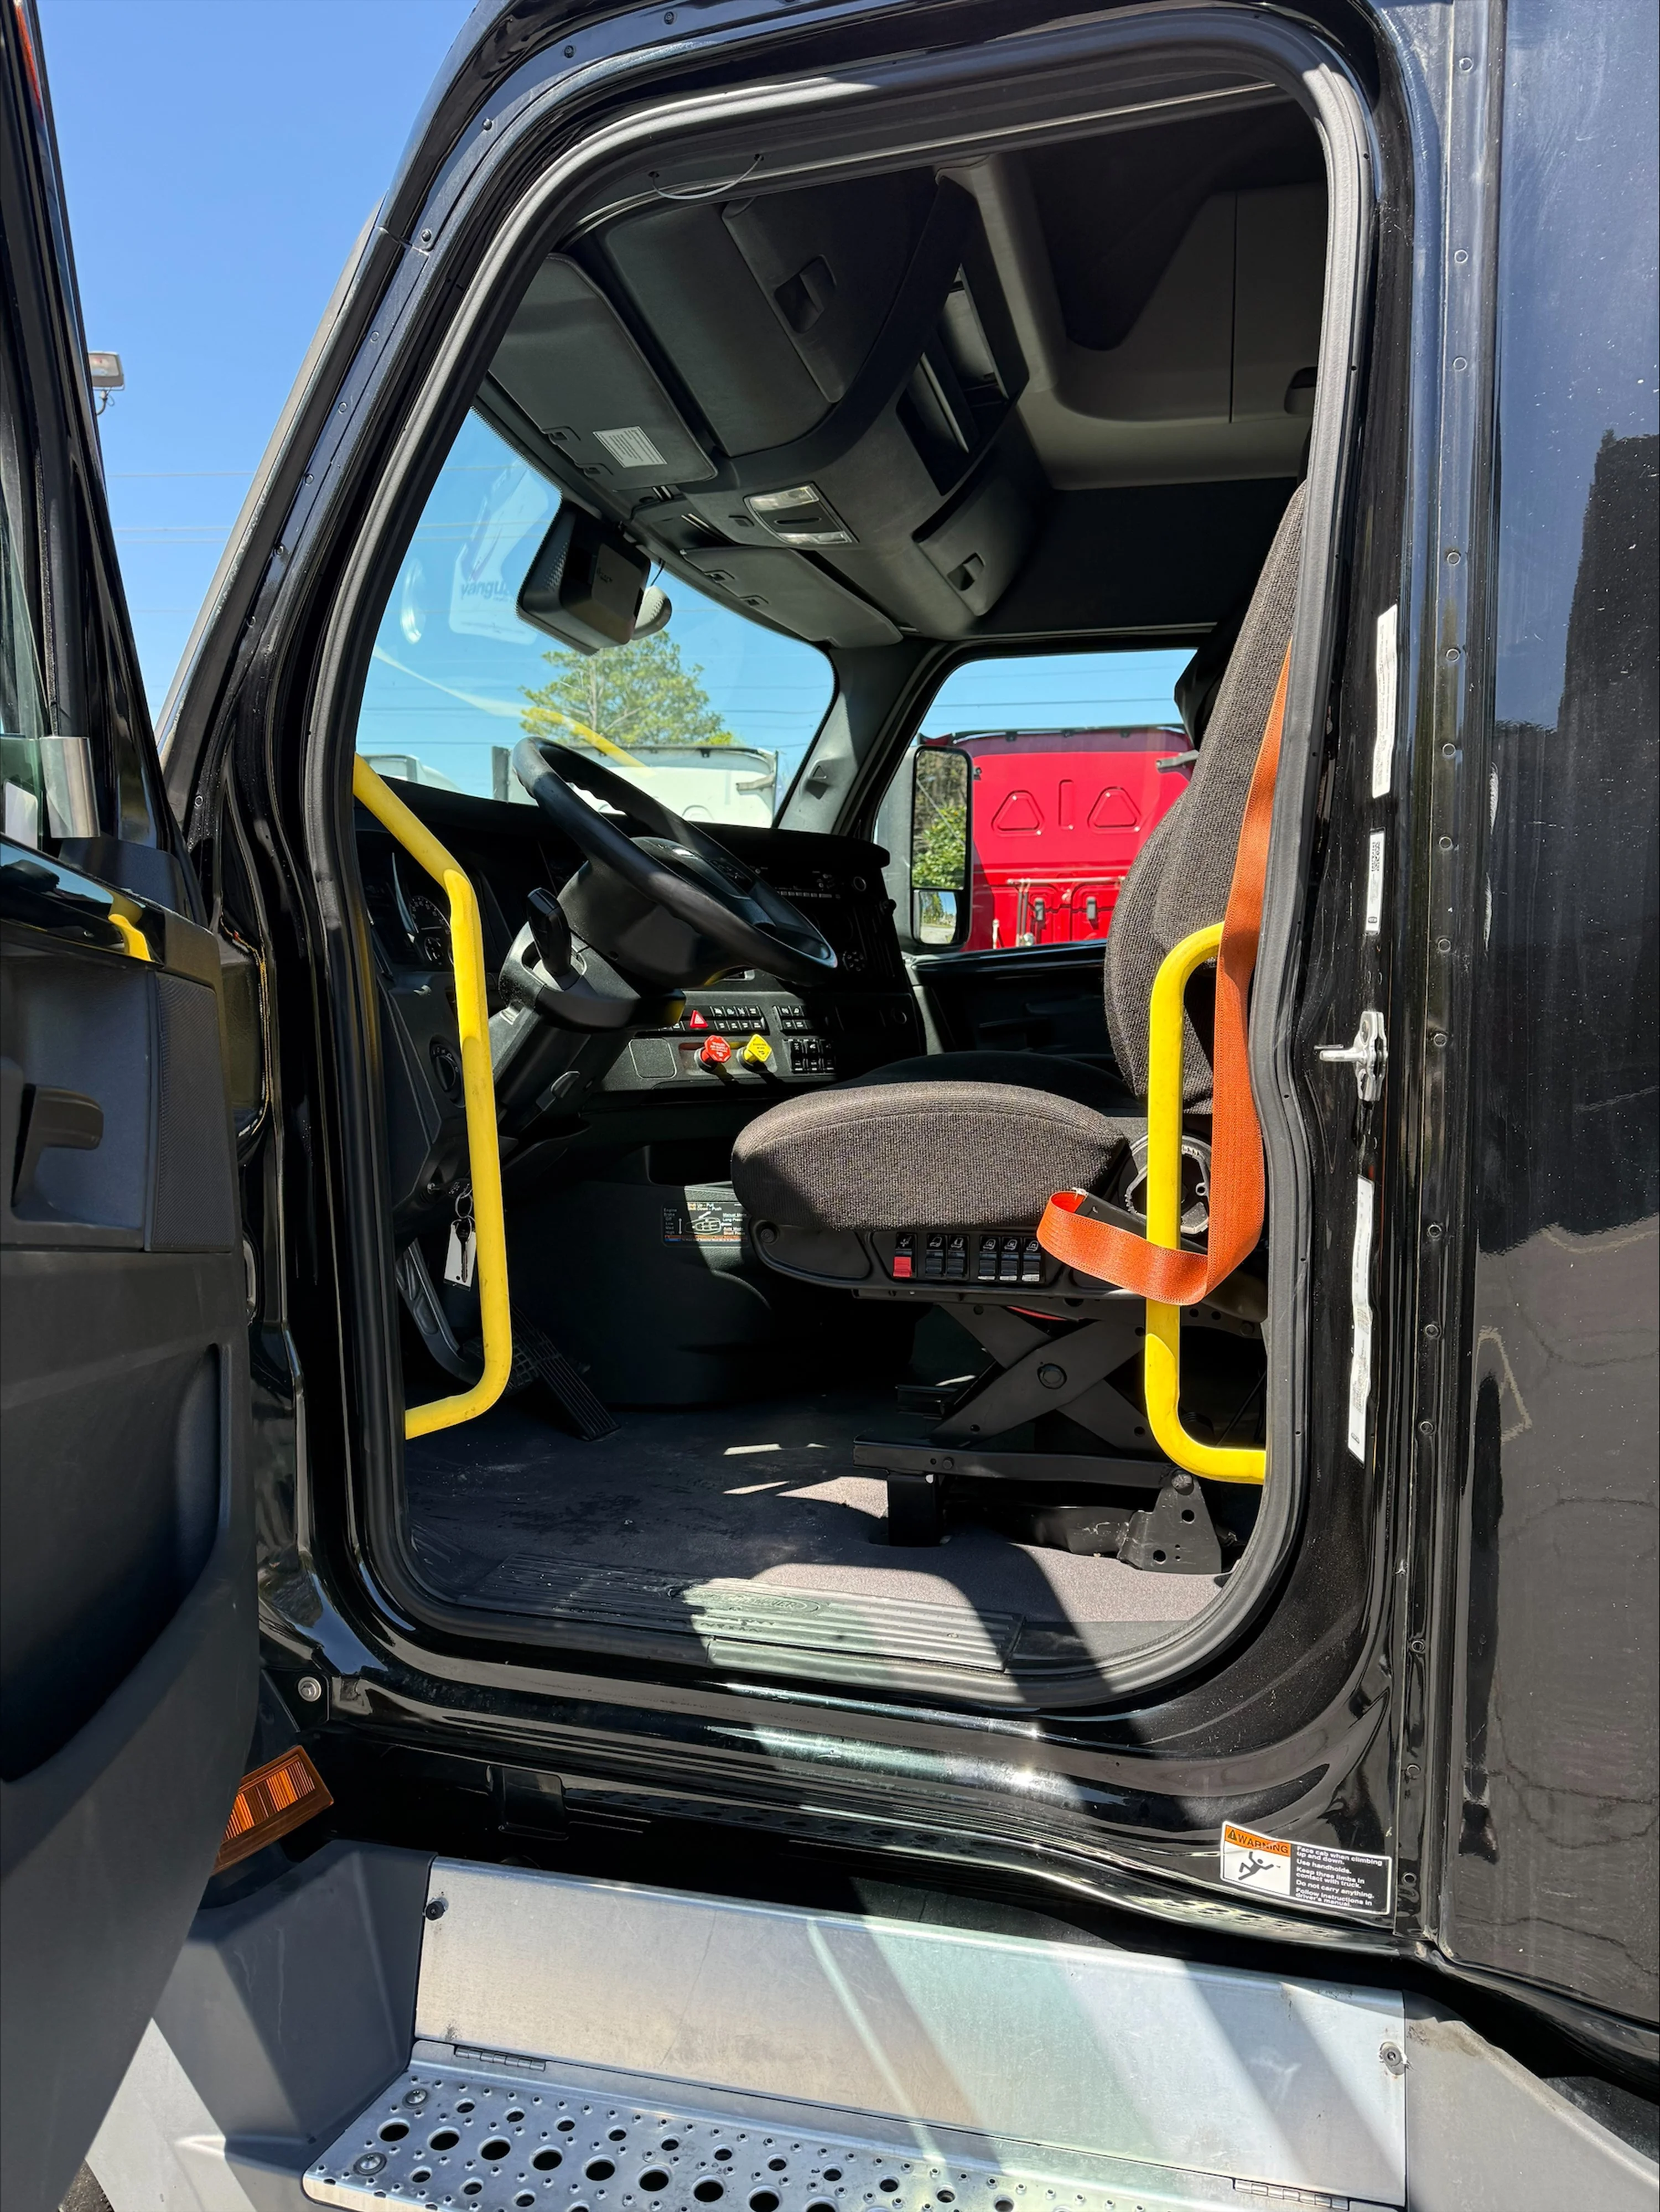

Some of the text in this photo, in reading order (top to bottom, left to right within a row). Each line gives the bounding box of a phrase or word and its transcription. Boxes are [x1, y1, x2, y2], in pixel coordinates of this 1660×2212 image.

[1238, 1834, 1289, 1853] WARNING
[1322, 1856, 1345, 1865] down.
[1351, 1856, 1383, 1867] climbing
[1296, 1867, 1315, 1876] Keep
[1316, 1871, 1335, 1879] three
[1336, 1874, 1356, 1882] limbs
[1311, 1862, 1352, 1874] handholds.
[1296, 1872, 1322, 1882] contact
[1341, 1880, 1361, 1888] truck.
[1295, 1893, 1352, 1907] driver's manual.
[1296, 1887, 1319, 1897] Follow
[1320, 1892, 1363, 1905] instructions
[1341, 1889, 1374, 1899] anything.
